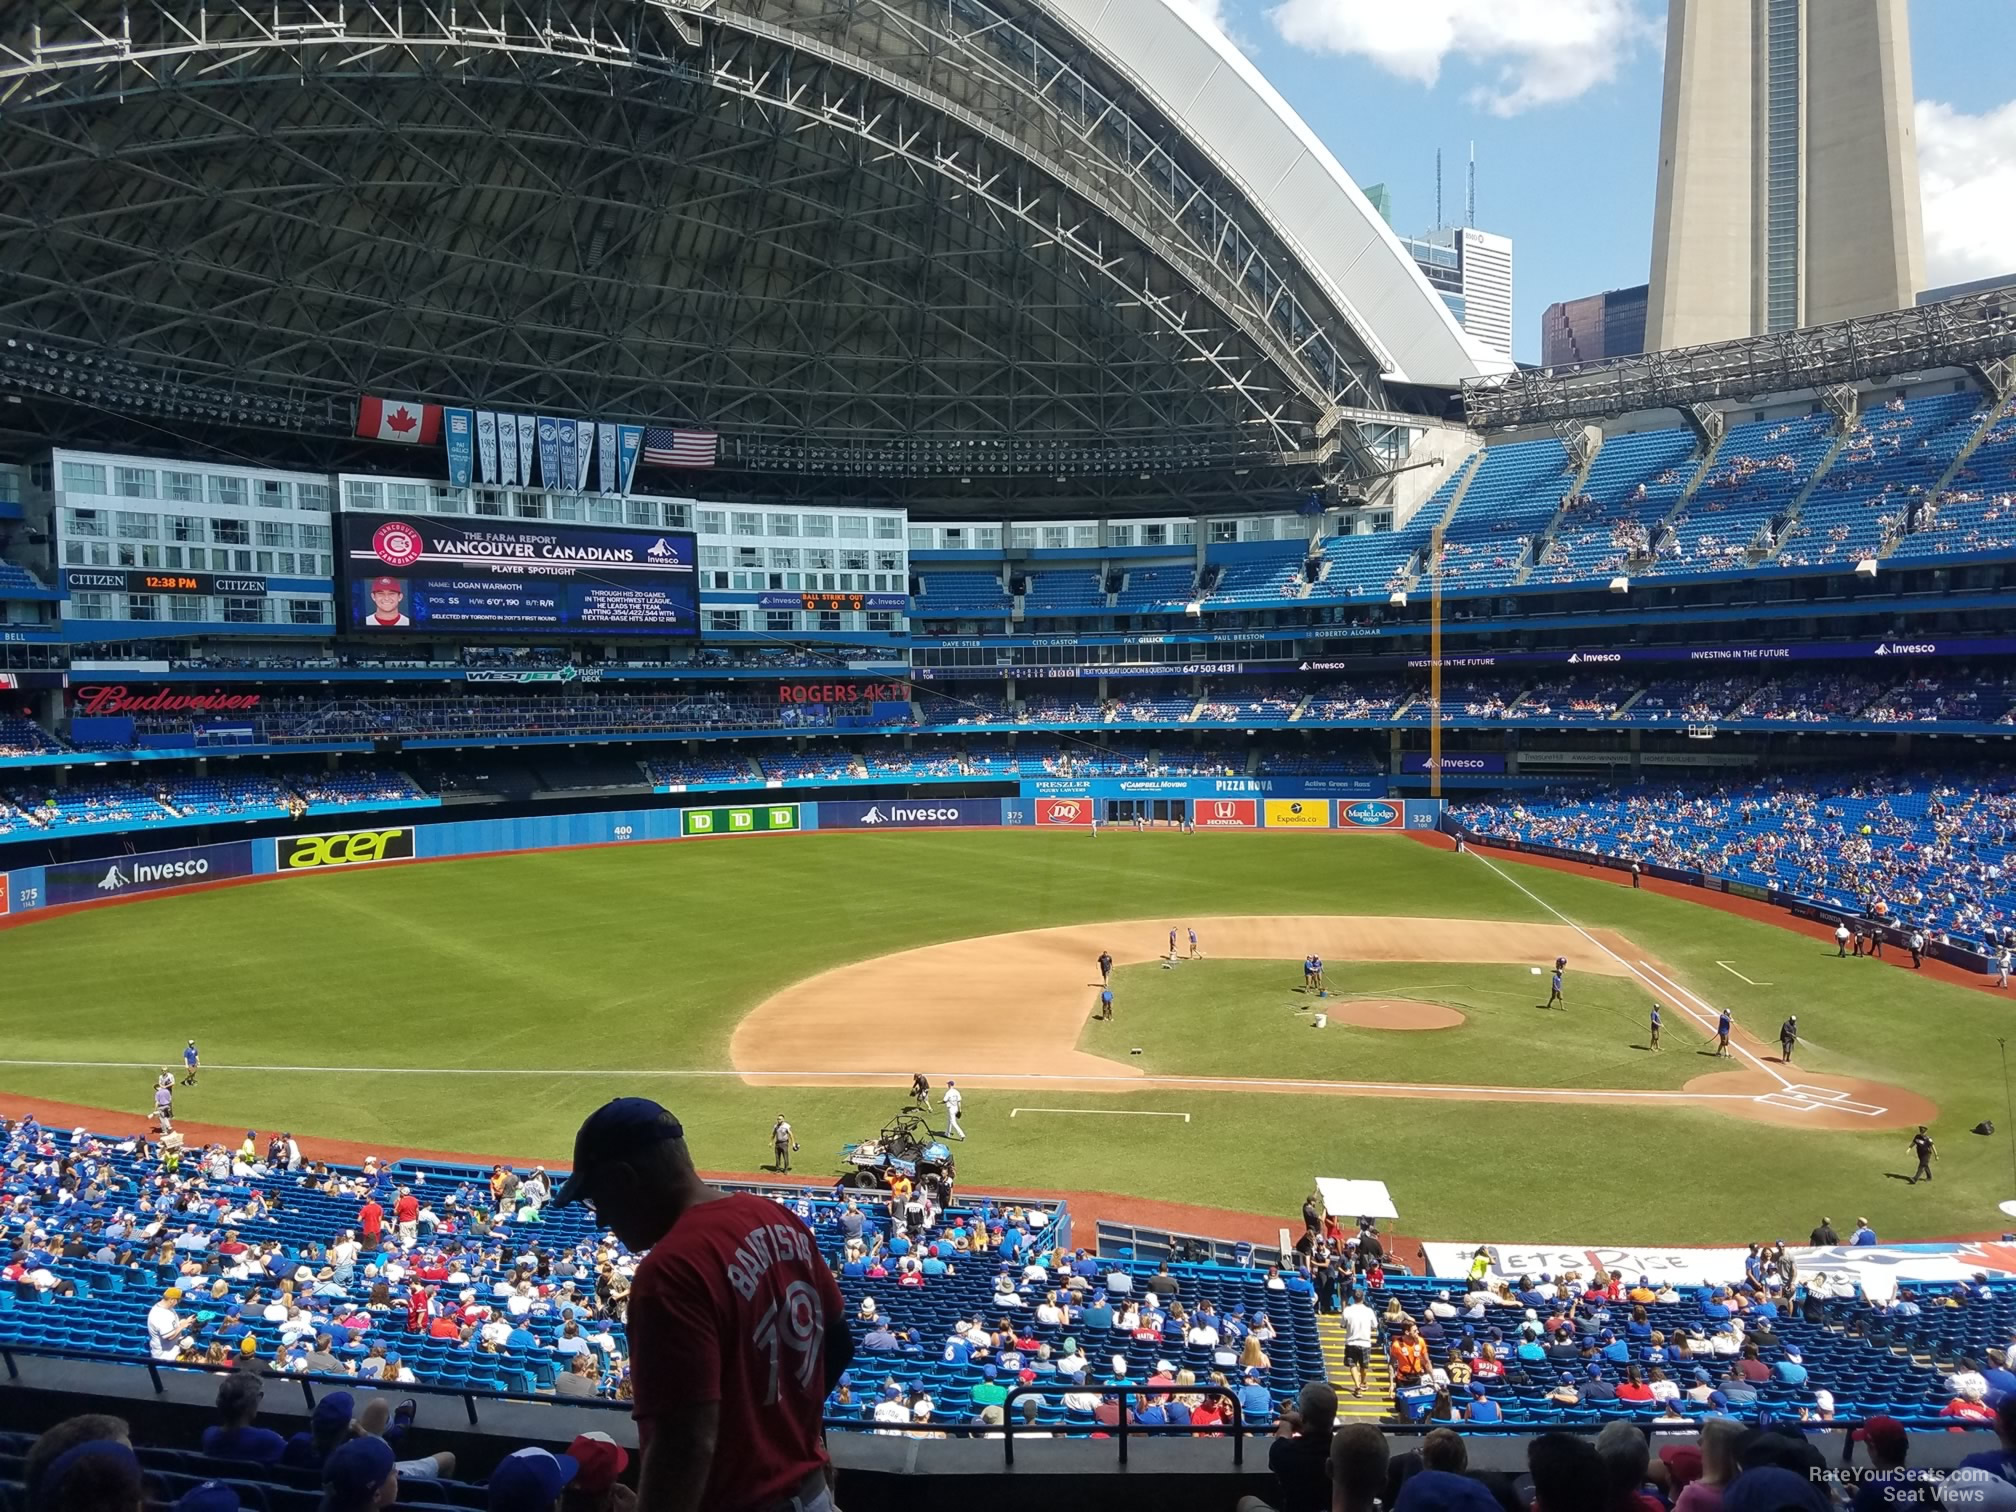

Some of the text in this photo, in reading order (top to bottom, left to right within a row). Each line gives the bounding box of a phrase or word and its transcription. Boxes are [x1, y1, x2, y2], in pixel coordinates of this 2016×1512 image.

[502, 440, 515, 450] 1989
[542, 444, 556, 454] 1992
[378, 524, 417, 539] VANCOUVER
[463, 532, 557, 544] THE FARM REPORT
[378, 550, 417, 564] CANADIANS
[433, 540, 634, 562] VANCOUVER CANADIANS
[648, 556, 678, 564] Invesco
[491, 565, 576, 576] PLAYER SPOTLIGHT
[68, 573, 124, 586] CITIZEN
[146, 576, 197, 589] 12:38 PM
[216, 579, 265, 592] CITIZEN
[807, 601, 861, 610] 0 0 0
[1691, 651, 1731, 659] INVESTING
[1759, 649, 1789, 657] FUTURE
[1892, 643, 1935, 654] Invesco
[1583, 653, 1621, 662] Invesco
[1312, 661, 1345, 670] Invesco
[467, 671, 559, 682] WESTJET
[779, 685, 858, 702] ROGERS
[78, 686, 260, 714] Budweiser
[1441, 758, 1484, 768] Invesco
[1216, 780, 1272, 791] PIZZA NOVA
[891, 807, 959, 822] Invesco
[1053, 805, 1075, 817] DQ
[1348, 810, 1394, 819] Maple Lodge
[691, 814, 710, 828] TD
[731, 813, 750, 826] TD
[772, 811, 790, 824] TD
[1277, 815, 1316, 823] Expedia.ca
[614, 826, 632, 834] 400
[288, 830, 402, 867] acer
[134, 858, 208, 883] Invesco
[20, 888, 38, 901] 375
[1820, 912, 1841, 922] HONDA
[797, 1205, 808, 1217] 55
[1808, 1290, 1825, 1300] STAFF
[945, 1345, 954, 1360] 6
[1452, 1368, 1471, 1383] 22
